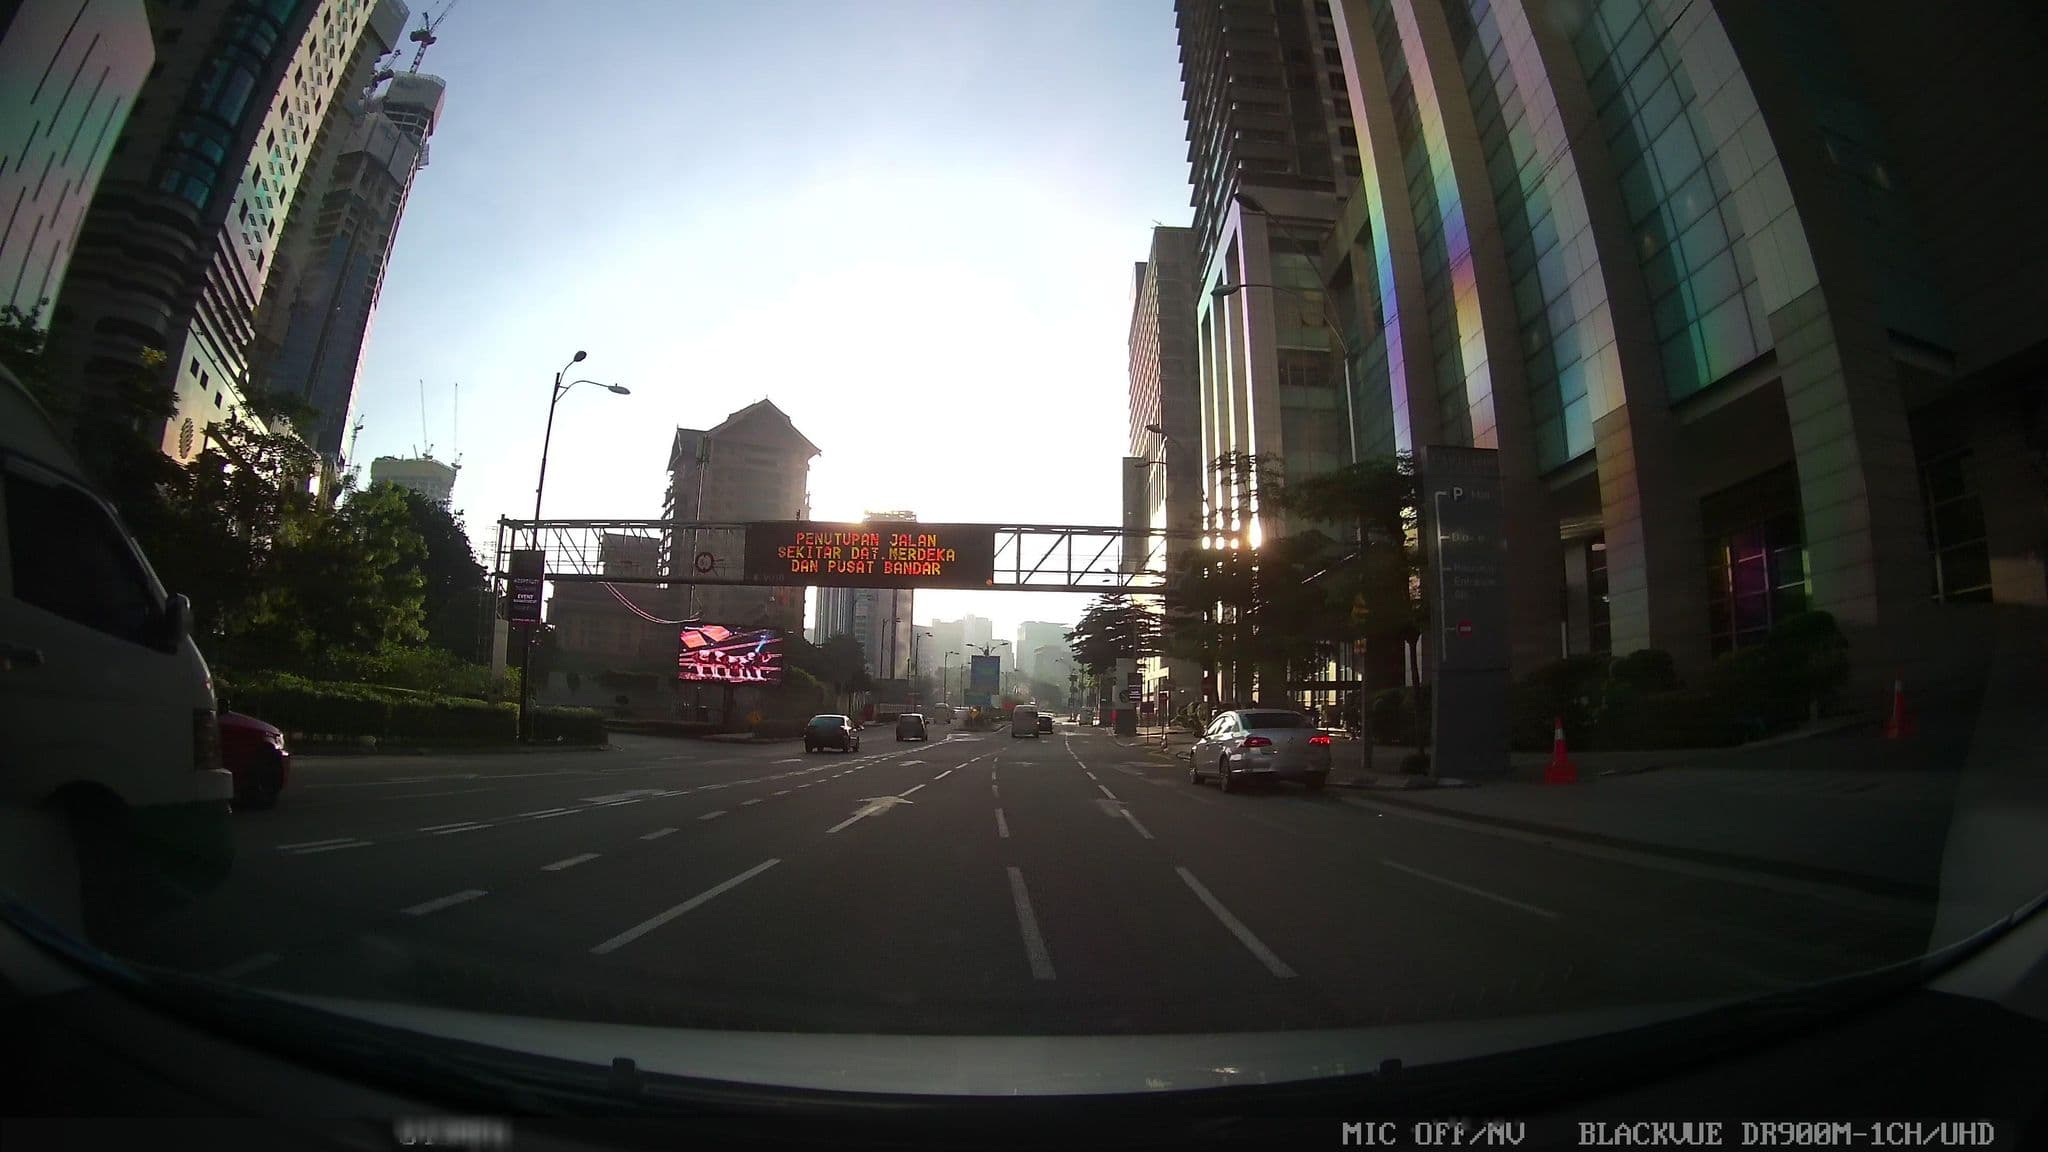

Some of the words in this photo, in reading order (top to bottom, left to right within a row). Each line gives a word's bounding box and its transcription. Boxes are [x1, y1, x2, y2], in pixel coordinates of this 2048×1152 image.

[796, 532, 880, 546] PENUTUPAN
[889, 533, 937, 547] JALAN
[778, 546, 842, 559] SEKITAR
[791, 560, 818, 573] DAN
[828, 561, 874, 573] PUSAT
[884, 561, 941, 575] BANDAR
